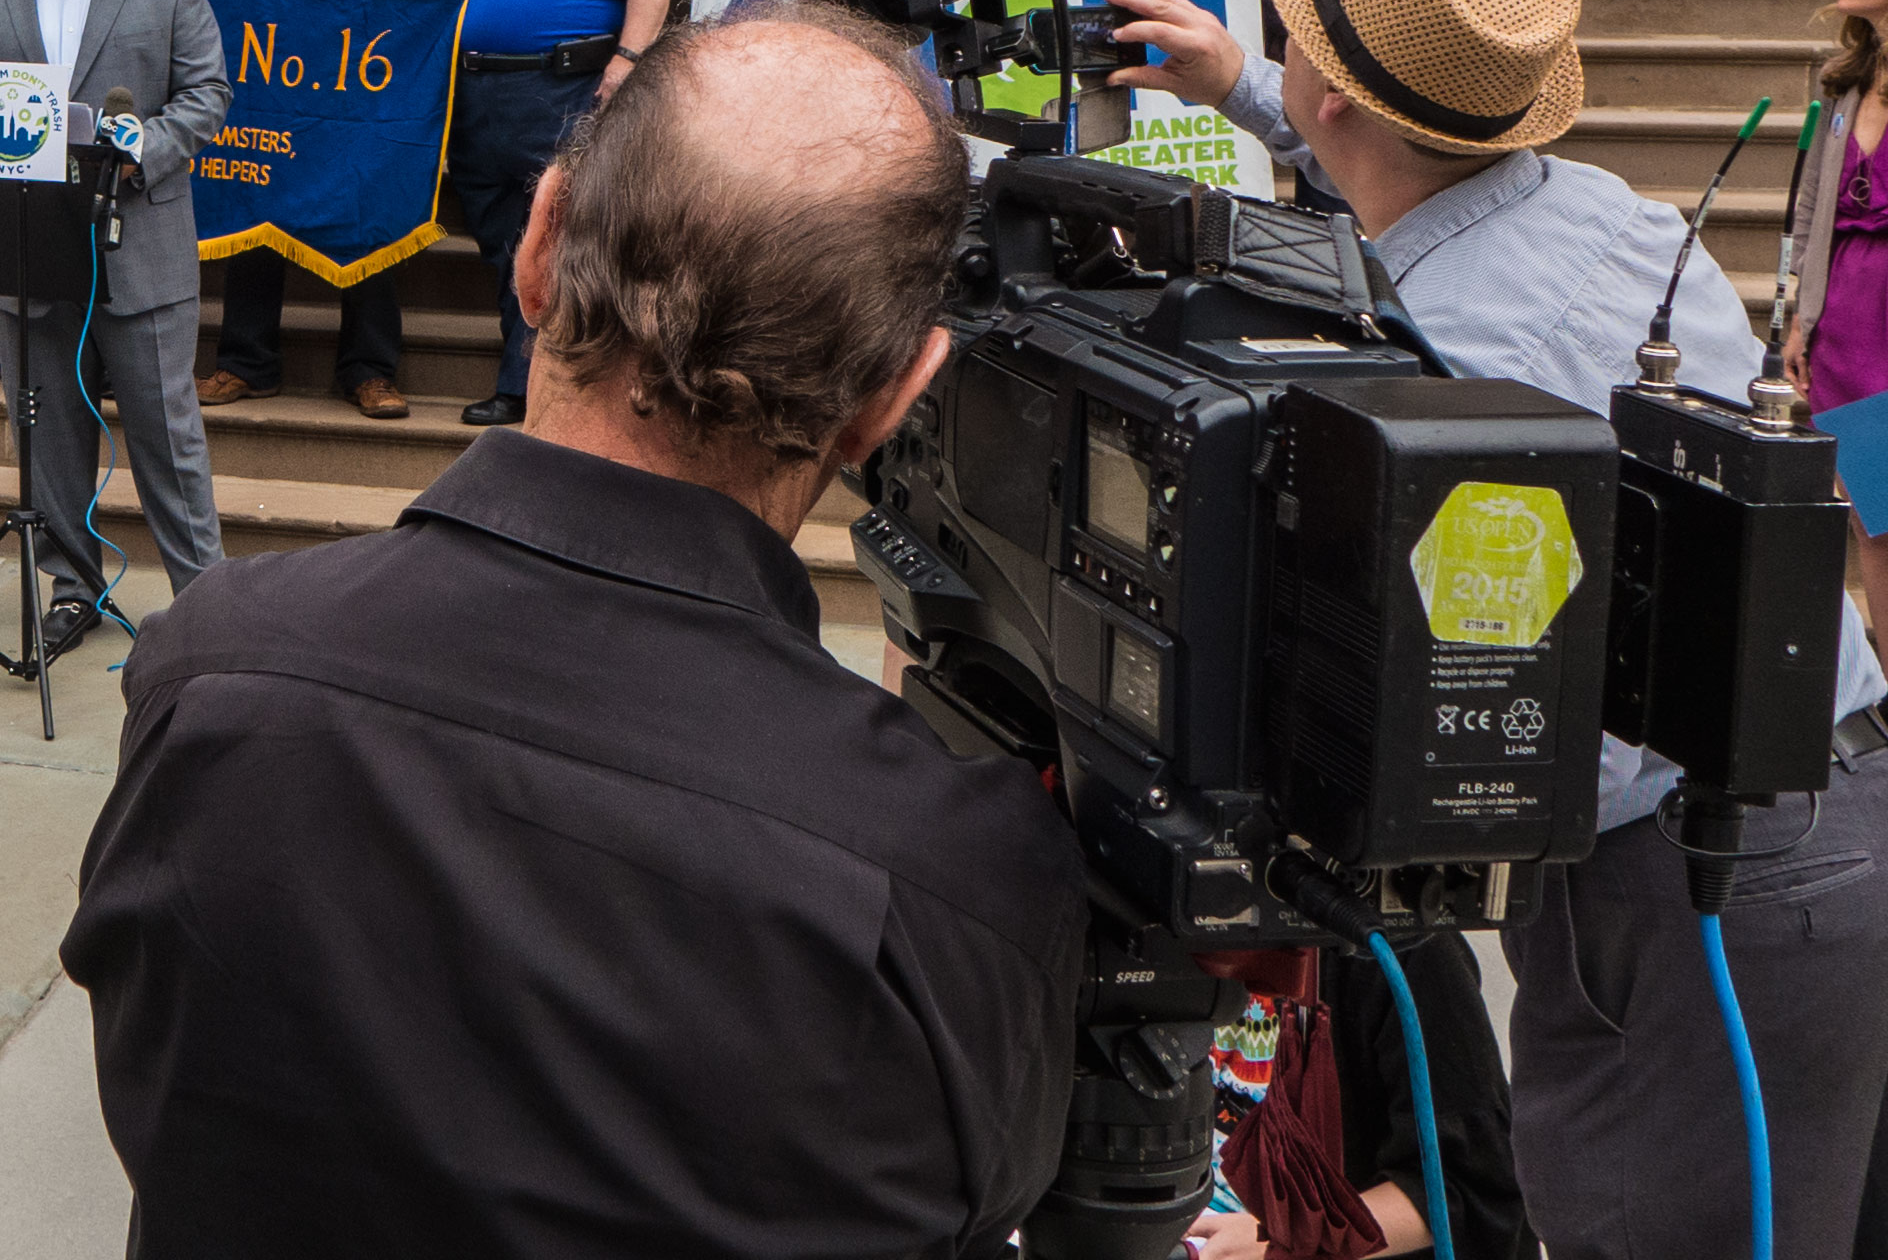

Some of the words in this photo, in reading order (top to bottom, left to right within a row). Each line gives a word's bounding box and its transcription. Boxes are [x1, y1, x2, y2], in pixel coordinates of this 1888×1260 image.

[13, 69, 47, 91] DON'T
[46, 91, 62, 132] TRASH
[1130, 114, 1235, 141] IANCE
[200, 157, 272, 186] HELPERS
[1159, 164, 1240, 186] ORK
[1481, 519, 1531, 539] OPEN
[1452, 571, 1528, 604] 2015
[1505, 744, 1537, 755] Li-ion
[1458, 782, 1515, 794] FLB-240
[1115, 971, 1156, 983] SPEED
